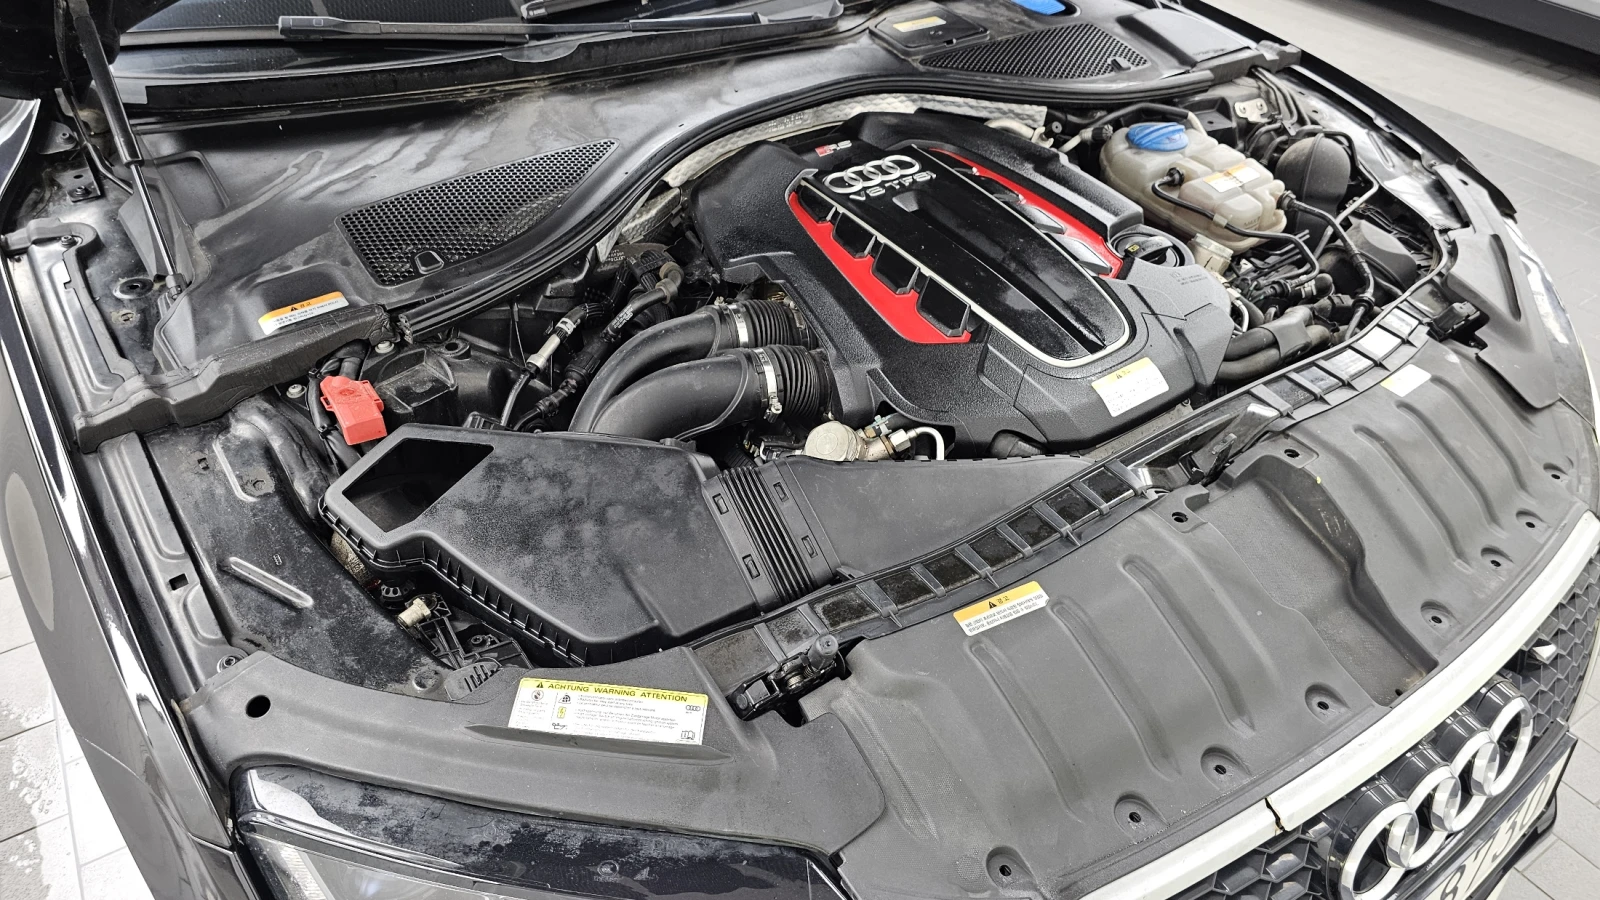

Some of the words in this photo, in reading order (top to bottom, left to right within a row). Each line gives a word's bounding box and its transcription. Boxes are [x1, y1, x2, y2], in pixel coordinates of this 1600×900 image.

[849, 186, 886, 200] V8
[884, 170, 937, 190] TFSI
[548, 683, 590, 692] ACHTUNG
[594, 687, 636, 697] WARNING
[640, 691, 688, 702] ATTENTION
